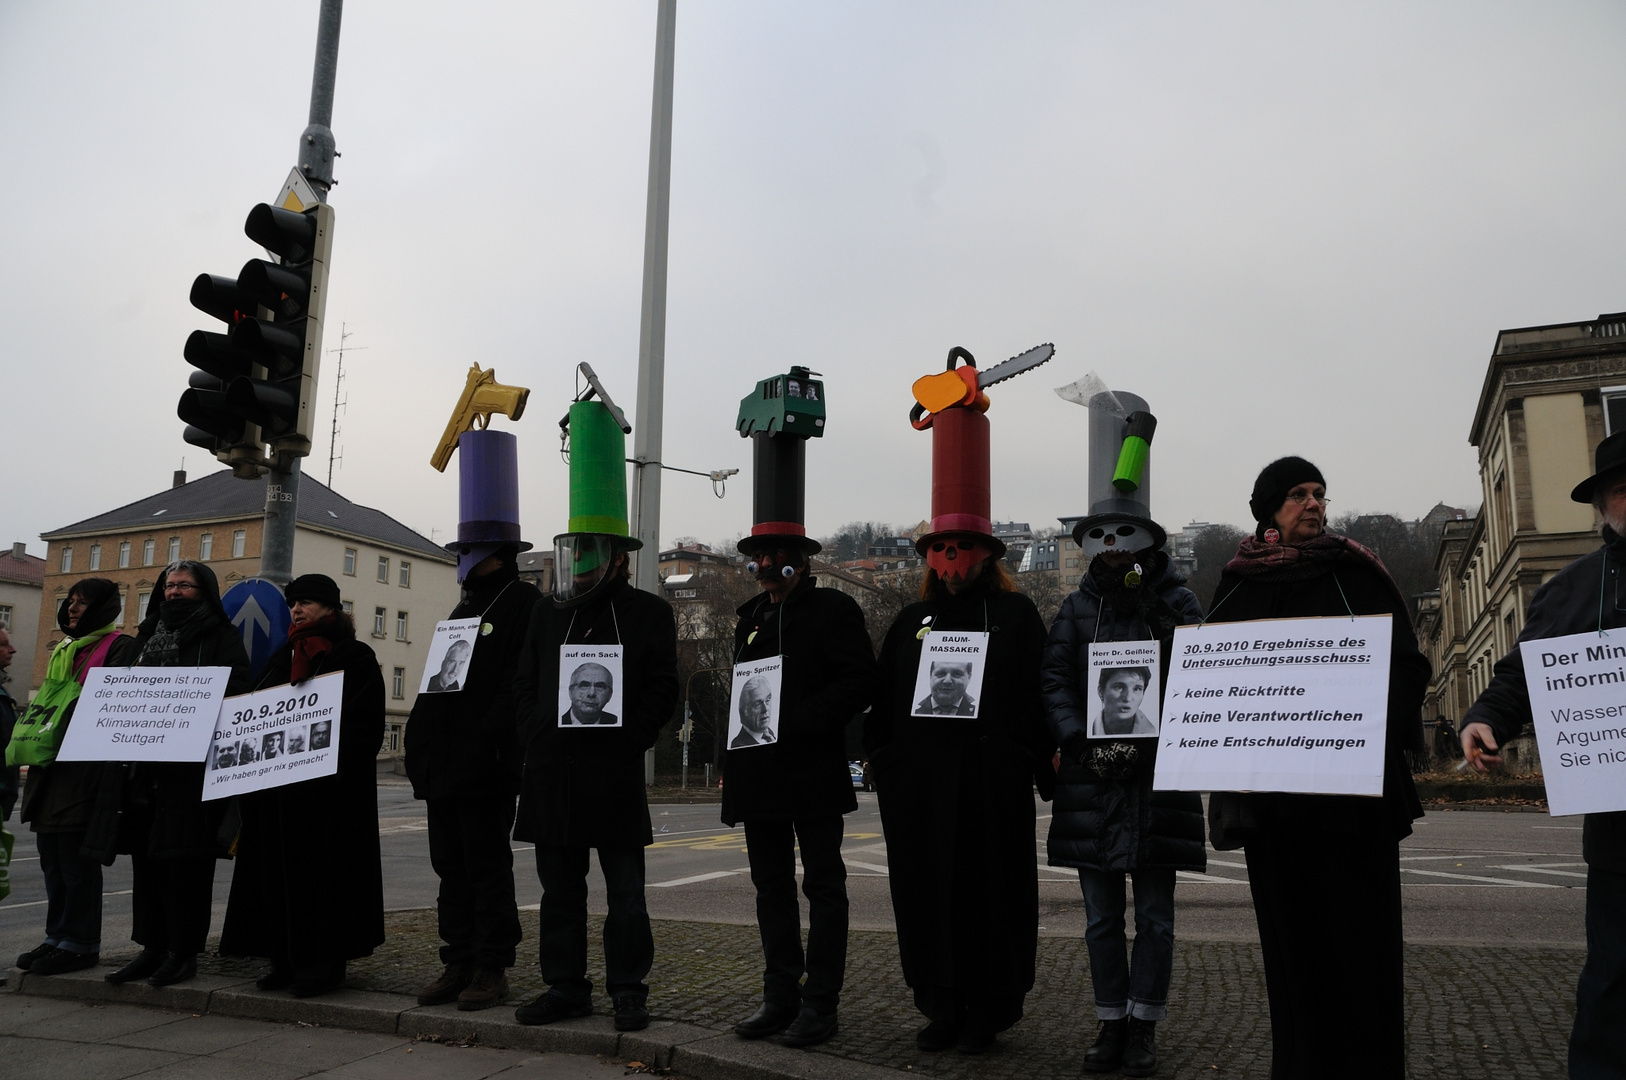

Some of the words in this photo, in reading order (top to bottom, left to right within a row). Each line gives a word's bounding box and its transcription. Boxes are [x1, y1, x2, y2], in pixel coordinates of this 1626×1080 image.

[930, 645, 980, 653] MASSAKER
[1184, 640, 1249, 655] 30.9.2010
[1253, 638, 1334, 652] Ergebnisse
[1338, 637, 1366, 648] des
[1182, 653, 1371, 669] Untersuchungsausschuss:
[1542, 652, 1579, 668] Der
[754, 664, 781, 675] Spritzer
[103, 674, 171, 686] Sprühregen
[175, 675, 189, 685] ist
[192, 676, 213, 685] nur
[94, 689, 112, 699] die
[116, 689, 212, 700] rechtsstaatliche
[1185, 688, 1224, 698] keine
[1228, 686, 1306, 697] Rücktritte
[98, 703, 146, 714] Antwort
[150, 703, 170, 714] auf
[173, 704, 196, 714] den
[232, 692, 319, 725] 30.9.2010
[96, 718, 176, 729] Klimawandel
[178, 718, 190, 729] in
[214, 730, 232, 740] Die
[235, 706, 334, 736] Unschuldslämmer
[1182, 711, 1222, 724] keine
[1227, 710, 1363, 723] Verantwortlichen
[111, 733, 165, 745] Stuttgart
[1179, 737, 1218, 748] keine
[1223, 736, 1366, 750] Entschuldigungen
[1560, 753, 1591, 768] Sie
[232, 770, 256, 780] haben
[258, 766, 272, 776] gar
[274, 763, 286, 772] nix
